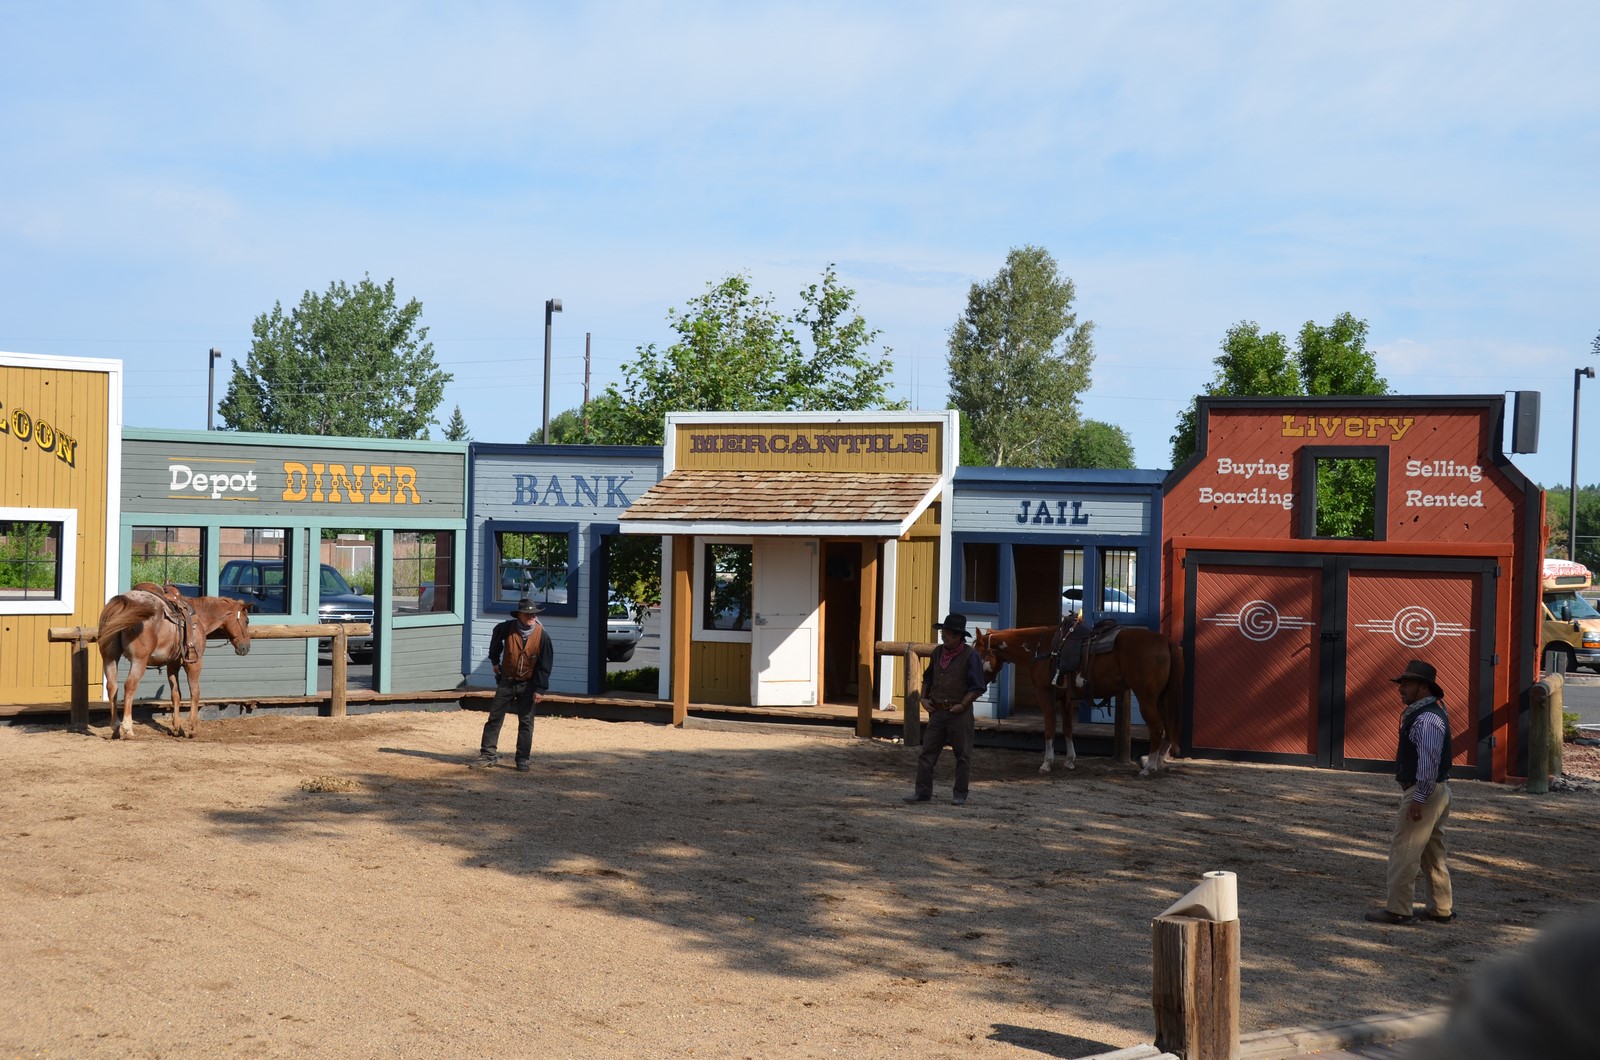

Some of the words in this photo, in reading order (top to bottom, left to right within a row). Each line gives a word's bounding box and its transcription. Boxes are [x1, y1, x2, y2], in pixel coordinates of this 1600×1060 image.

[1281, 415, 1415, 441] Livery
[690, 434, 929, 454] MERCANTILE
[1217, 457, 1290, 480] Buying
[1405, 460, 1483, 482] Selling
[168, 464, 257, 499] Depot
[282, 462, 421, 505] DINER
[512, 474, 634, 508] BANK
[1199, 487, 1295, 510] Boarding
[1405, 490, 1484, 507] Rented
[1016, 500, 1089, 526] JAIL
